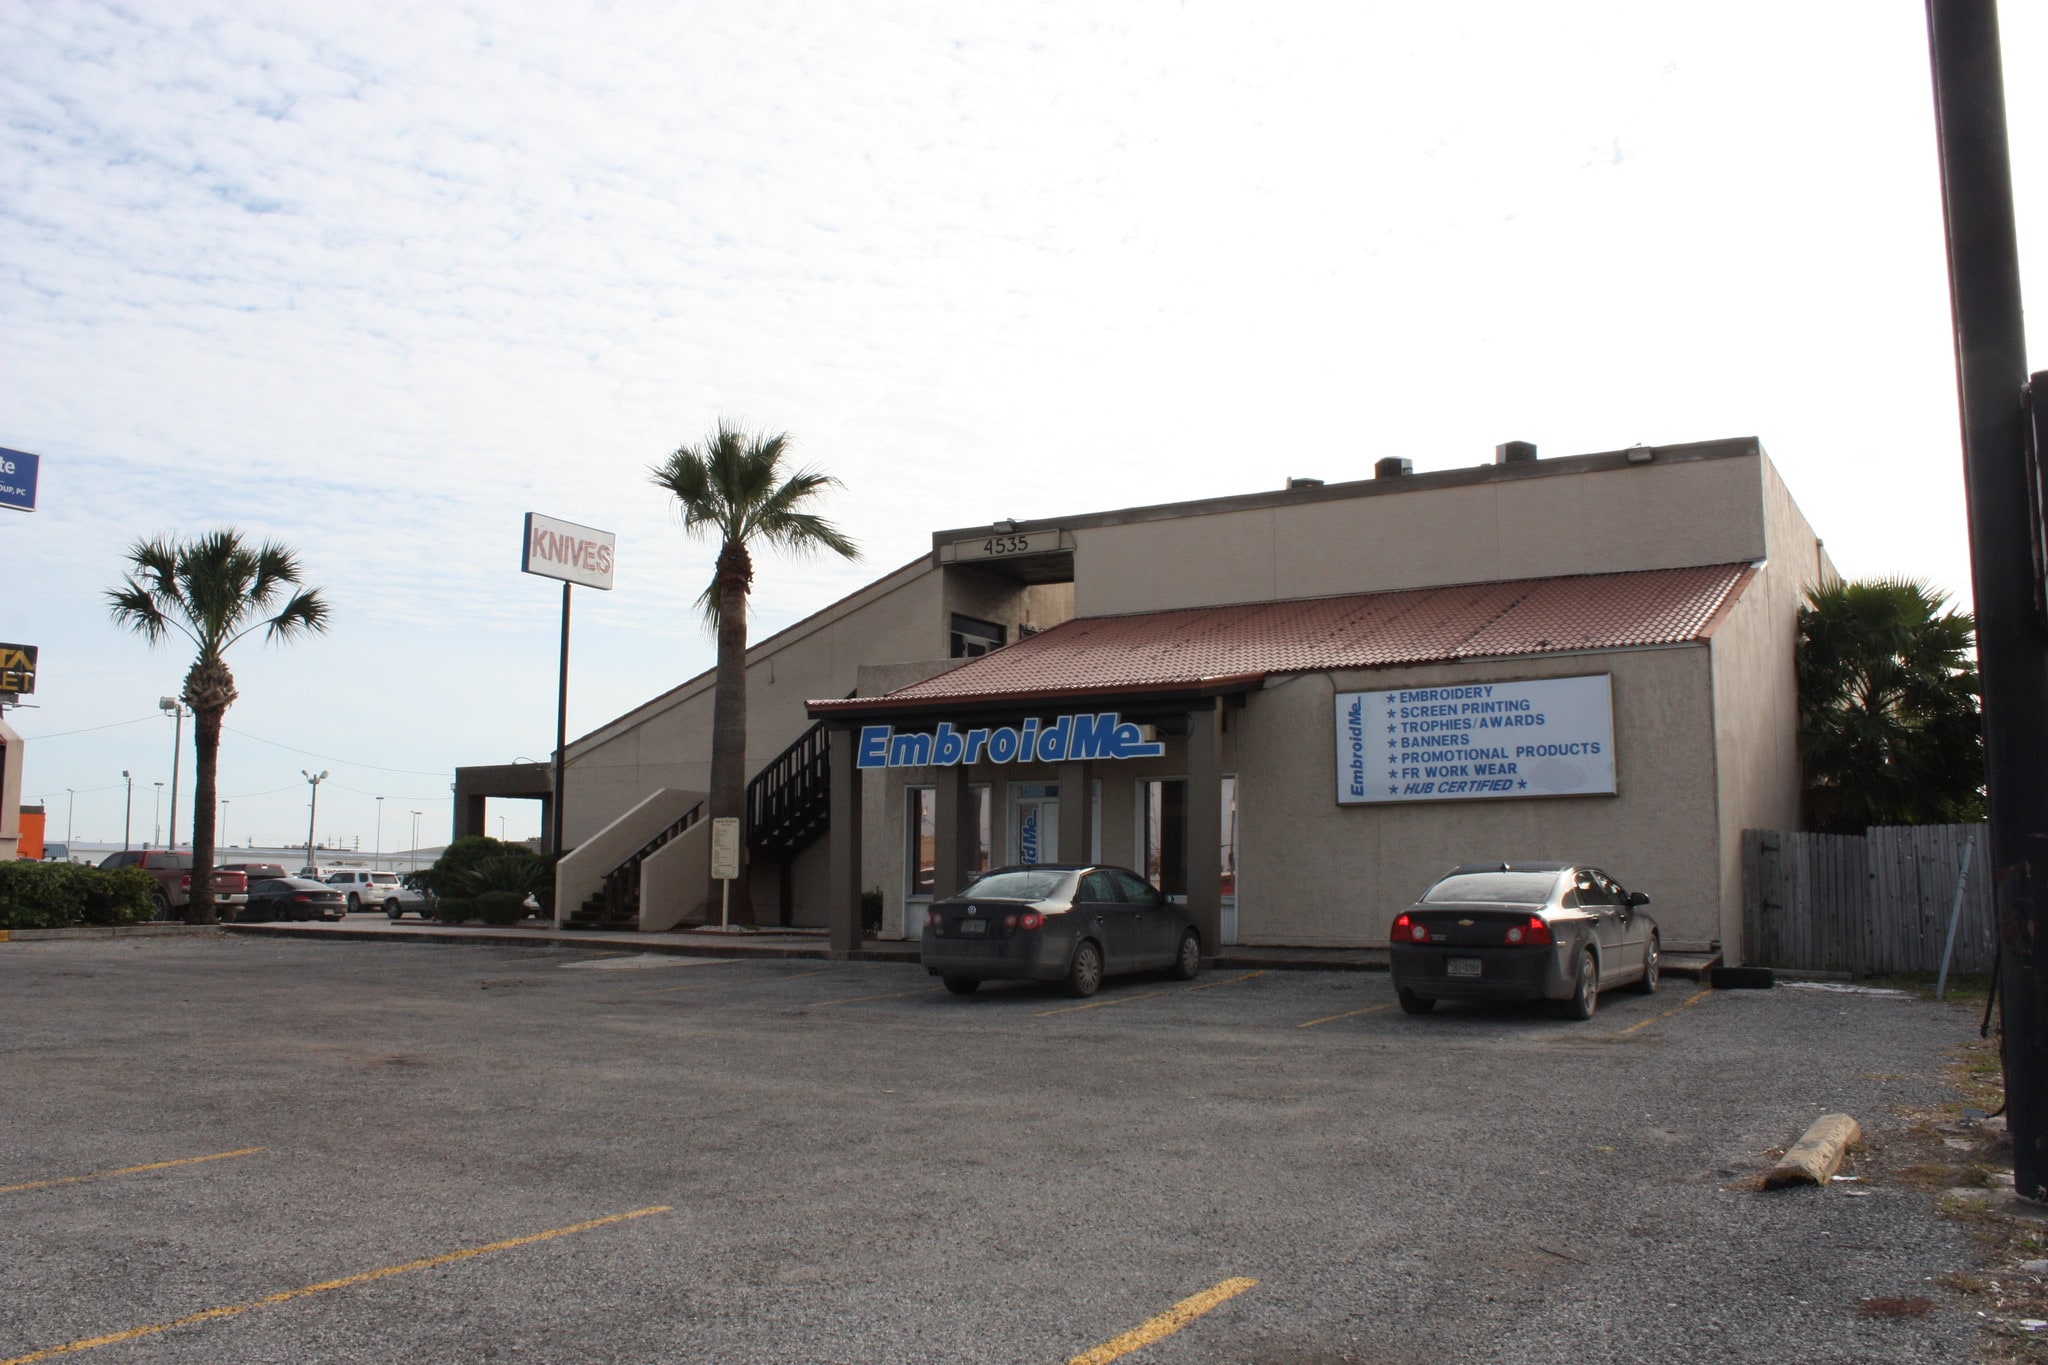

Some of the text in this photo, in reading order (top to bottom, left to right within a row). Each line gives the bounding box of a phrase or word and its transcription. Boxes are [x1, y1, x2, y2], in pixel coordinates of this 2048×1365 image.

[16, 488, 27, 496] PC
[532, 527, 611, 575] KNIVES
[983, 535, 1028, 555] 4535
[1400, 686, 1493, 703] EMBROIDERY
[1400, 699, 1530, 718] SCREEN PRINTING
[1400, 713, 1545, 733] TROPHIES/AWARDS
[856, 711, 1165, 769] EmbroidMe
[1348, 696, 1364, 796] EmbroidMe
[1401, 733, 1470, 748] BANNERS
[1401, 742, 1601, 764] PROMOTIONAL PRODUCTS
[1401, 762, 1517, 779] FR WORK WEAR
[1403, 779, 1513, 795] HUB CERTIFIED
